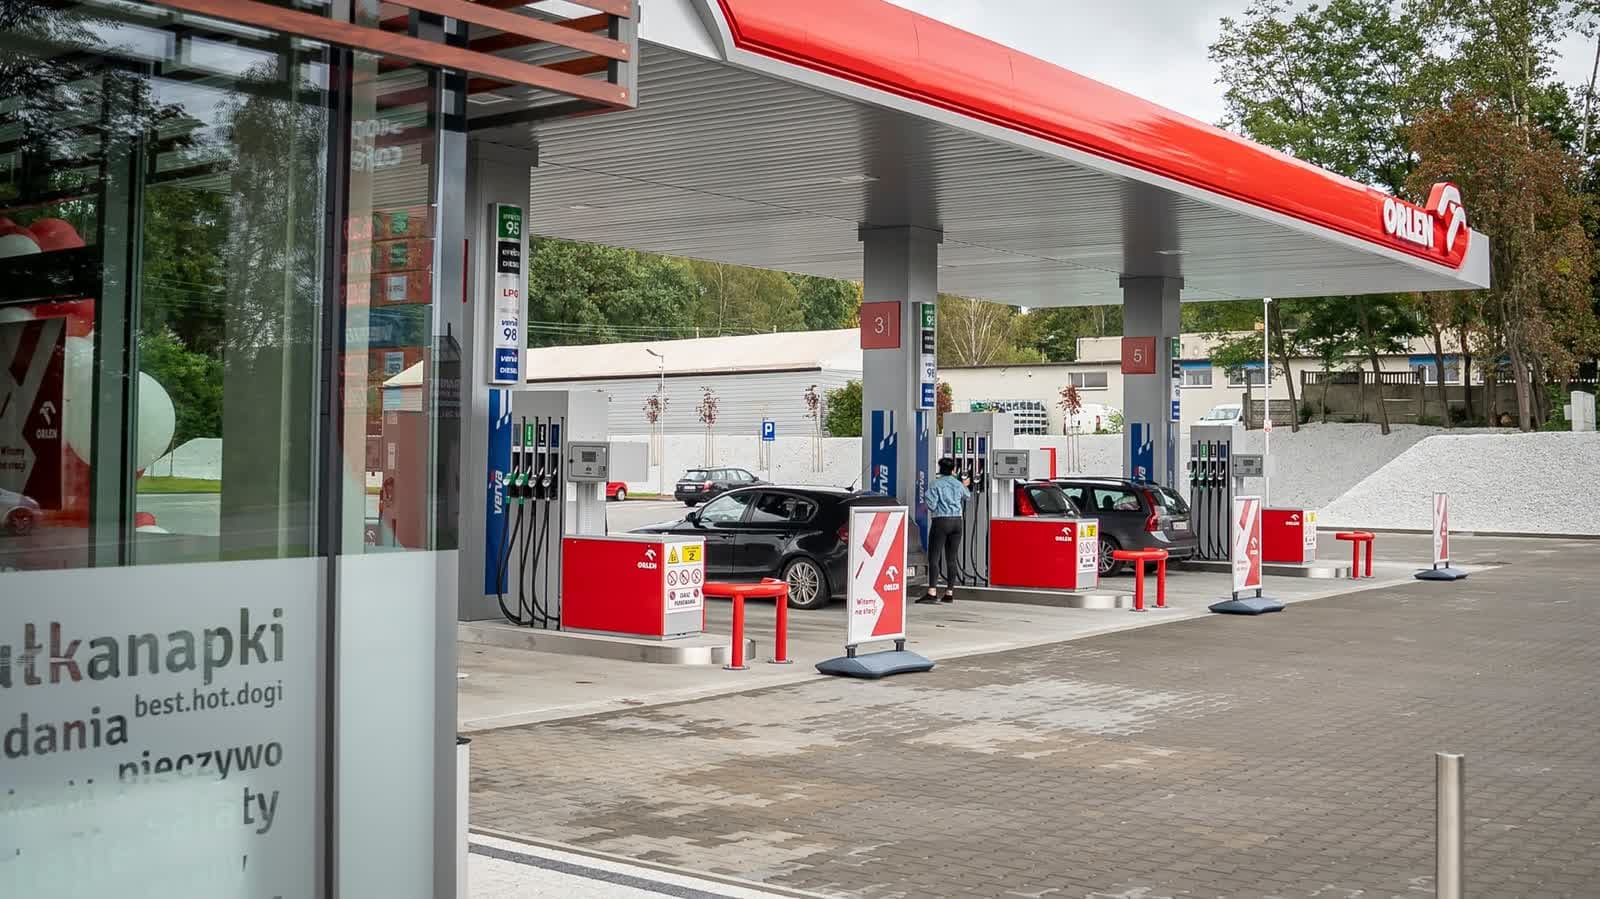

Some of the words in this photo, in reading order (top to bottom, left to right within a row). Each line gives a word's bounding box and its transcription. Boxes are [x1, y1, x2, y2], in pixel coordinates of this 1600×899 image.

[506, 221, 520, 235] 95
[1383, 198, 1434, 248] ORLEN
[503, 289, 519, 298] LPG
[874, 317, 884, 334] 3
[503, 328, 517, 341] 98
[1133, 348, 1142, 363] 5
[765, 423, 773, 436] P
[879, 464, 889, 496] erva
[494, 470, 503, 514] verva
[637, 562, 657, 570] ORLEN
[883, 583, 900, 592] ORLEN
[135, 680, 283, 718] best.hot.dogi
[4, 706, 128, 759] dania
